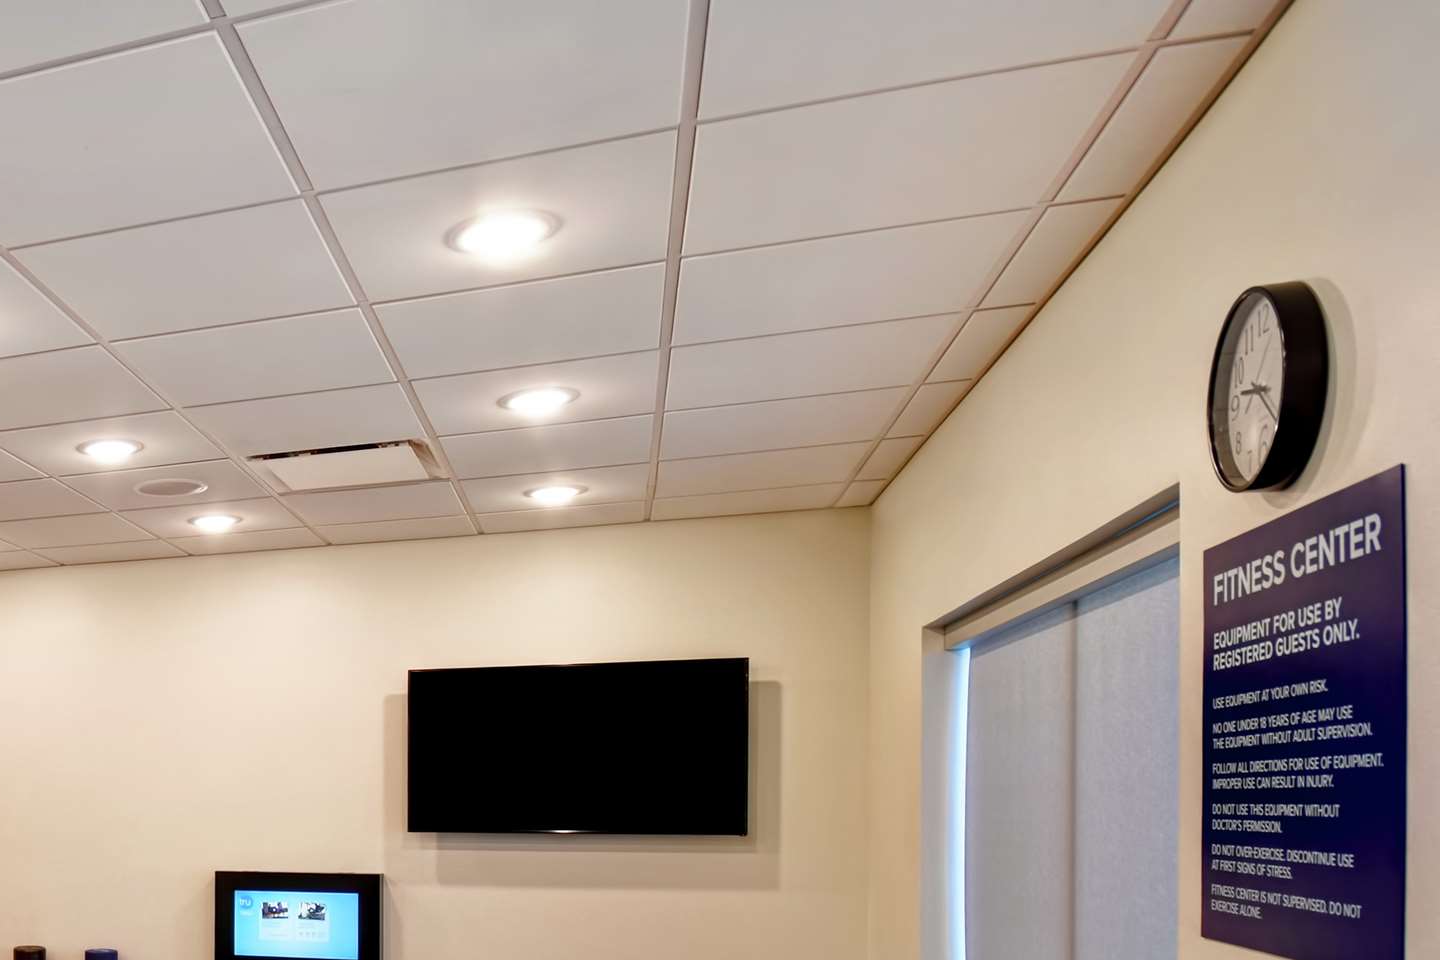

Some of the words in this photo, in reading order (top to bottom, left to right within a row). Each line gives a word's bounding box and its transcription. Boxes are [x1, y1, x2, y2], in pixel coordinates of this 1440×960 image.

[1258, 303, 1269, 336] 12
[1245, 325, 1253, 355] 11
[1235, 357, 1244, 389] 10
[1231, 395, 1240, 421] 9
[1236, 432, 1242, 455] 8
[1214, 550, 1285, 605] FITNESS
[1290, 513, 1381, 578] CENTER
[1214, 618, 1270, 650] EQUIPMENT
[1273, 611, 1295, 634] FOR
[1298, 602, 1322, 627] USE
[1325, 597, 1342, 620] BY
[1213, 641, 1273, 671] REGISTERED
[1276, 628, 1320, 657] GUESTS
[1323, 618, 1360, 645] ONLY.
[1213, 697, 1224, 709] USE
[1225, 691, 1260, 708] EQUIPMENT
[1261, 689, 1269, 701] AT
[1271, 685, 1289, 700] YOUR
[1291, 682, 1308, 697] OWN
[1310, 679, 1328, 693] RISK.
[1213, 723, 1222, 734] NO
[1223, 721, 1236, 732] ONE
[1237, 717, 1258, 731] UNDER
[1260, 717, 1267, 728] 18
[1268, 713, 1289, 727] YEARS
[1291, 712, 1300, 724] OF
[1302, 710, 1317, 723] AGE
[1318, 707, 1335, 722] MAY
[1336, 705, 1352, 719] USE
[1213, 738, 1224, 749] THE
[1225, 734, 1260, 748] EQUIPMENT
[1262, 731, 1291, 745] WITHOUT
[1293, 728, 1316, 742] ADULT
[1317, 722, 1372, 740] SUPERVISION.
[1212, 762, 1237, 774] FOLLOW
[1238, 762, 1249, 773] ALL
[1250, 759, 1287, 773] DIRECTIONS
[1289, 758, 1303, 771] FOR
[1304, 757, 1319, 770] USE
[1321, 756, 1332, 769] OF
[1333, 752, 1384, 768] EQUIPMENT.
[1212, 778, 1242, 790] IMPROPER
[1243, 778, 1255, 789] USE
[1257, 777, 1271, 789] CAN
[1271, 776, 1296, 788] RESULT
[1297, 775, 1304, 788] IN
[1306, 774, 1334, 788] INJURY.
[1212, 803, 1222, 815] DO
[1223, 803, 1235, 815] NOT
[1236, 803, 1248, 815] USE
[1250, 804, 1263, 815] THIS
[1265, 804, 1303, 816] EQUIPMENT
[1305, 804, 1339, 818] WITHOUT
[1212, 844, 1221, 855] DO
[1222, 845, 1235, 856] NOT
[1236, 846, 1285, 861] OVER-EXERCISE.
[1287, 850, 1336, 866] DISCONTINUE
[1338, 854, 1354, 868] USE
[1212, 860, 1219, 870] AT
[1220, 861, 1236, 873] FIRST
[1237, 862, 1256, 875] SIGNS
[1257, 864, 1266, 876] OF
[1267, 865, 1292, 879] STRESS.
[1212, 884, 1234, 898] FITNESS
[1236, 887, 1260, 900] CENTER
[1260, 891, 1267, 903] IS
[1268, 892, 1282, 905] NOT
[1282, 894, 1328, 913] SUPERVISED.
[1329, 901, 1341, 916] DO
[1343, 904, 1362, 918] NOT
[1212, 899, 1238, 915] EXERCISE
[1240, 904, 1262, 919] ALONE.
